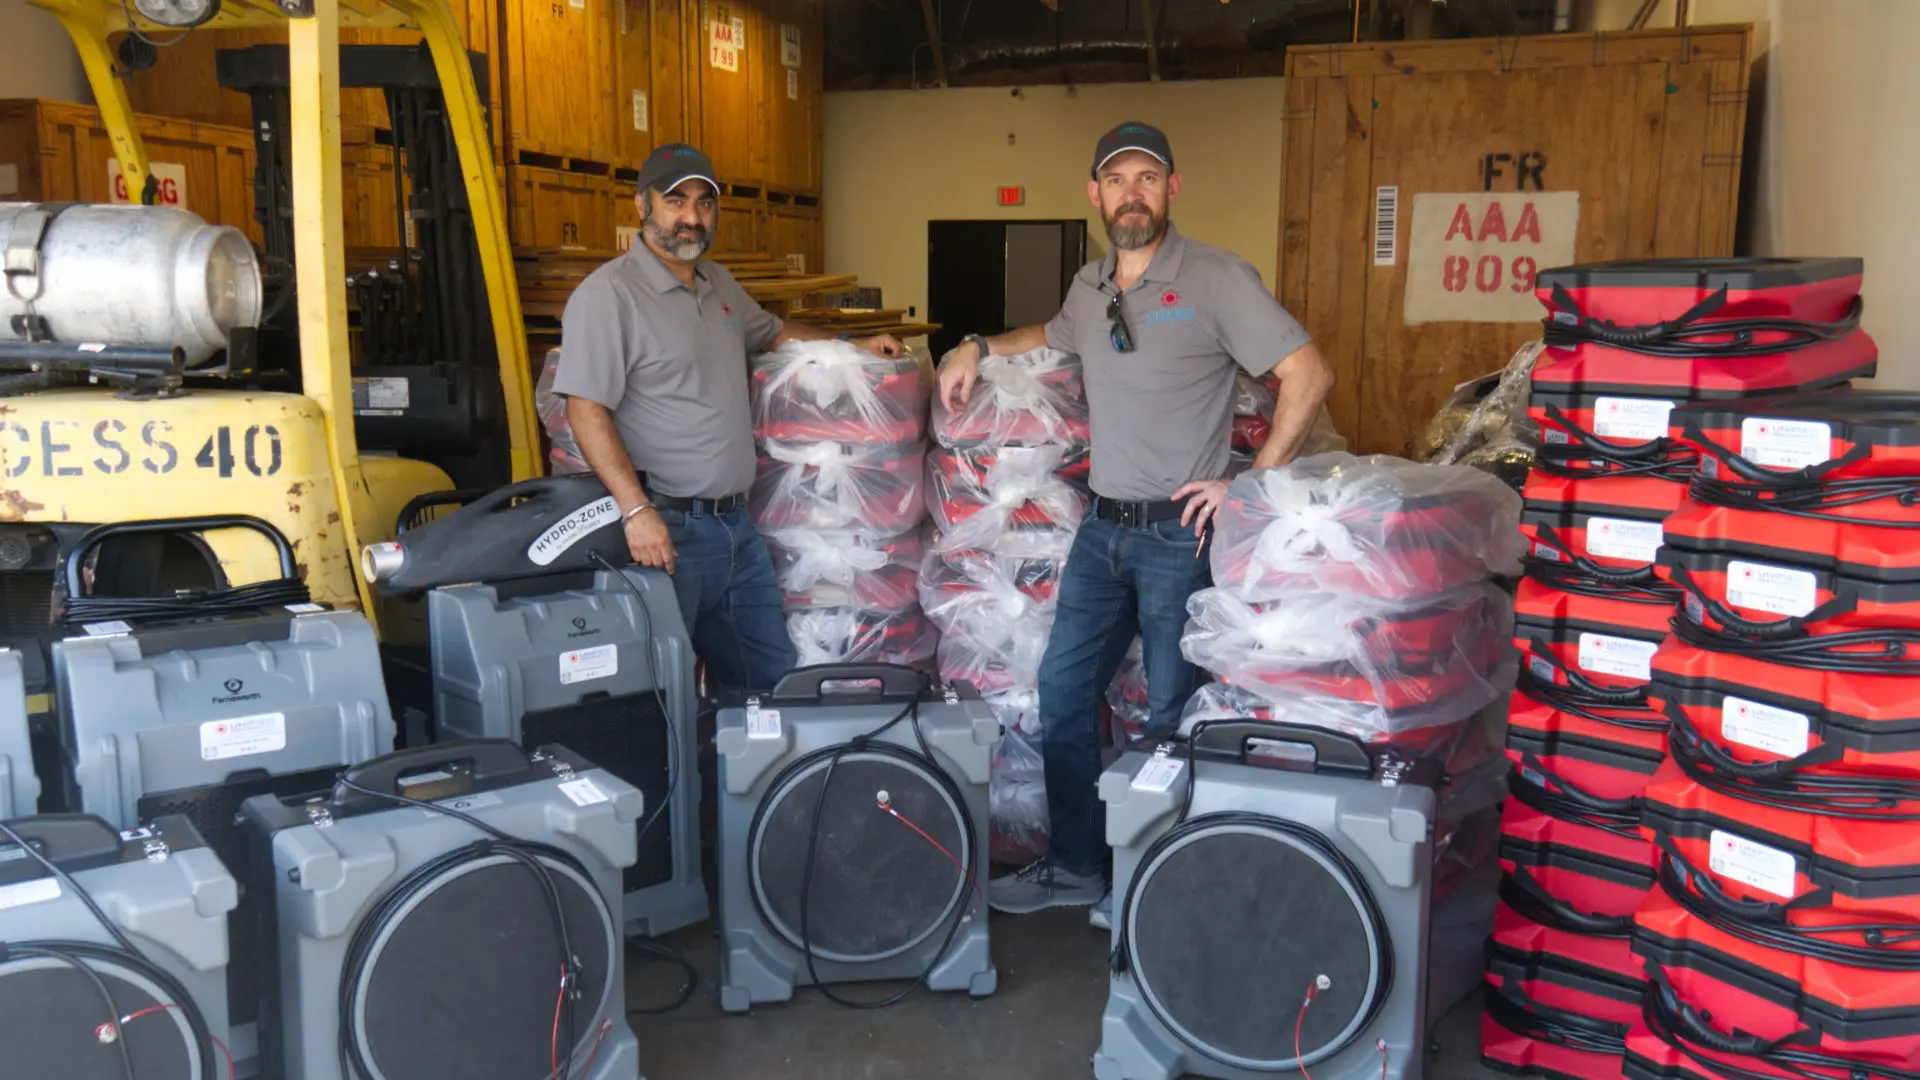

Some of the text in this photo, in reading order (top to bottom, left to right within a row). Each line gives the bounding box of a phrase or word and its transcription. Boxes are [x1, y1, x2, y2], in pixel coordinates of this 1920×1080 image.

[714, 24, 733, 43] AAA
[713, 47, 734, 67] 799
[1483, 151, 1546, 191] FR
[1001, 187, 1019, 203] EXIT
[562, 222, 578, 243] FR
[1445, 201, 1542, 244] AAA
[1442, 254, 1537, 293] 809
[0, 419, 281, 478] CESS 40
[536, 501, 614, 553] HYDRO-ZONE
